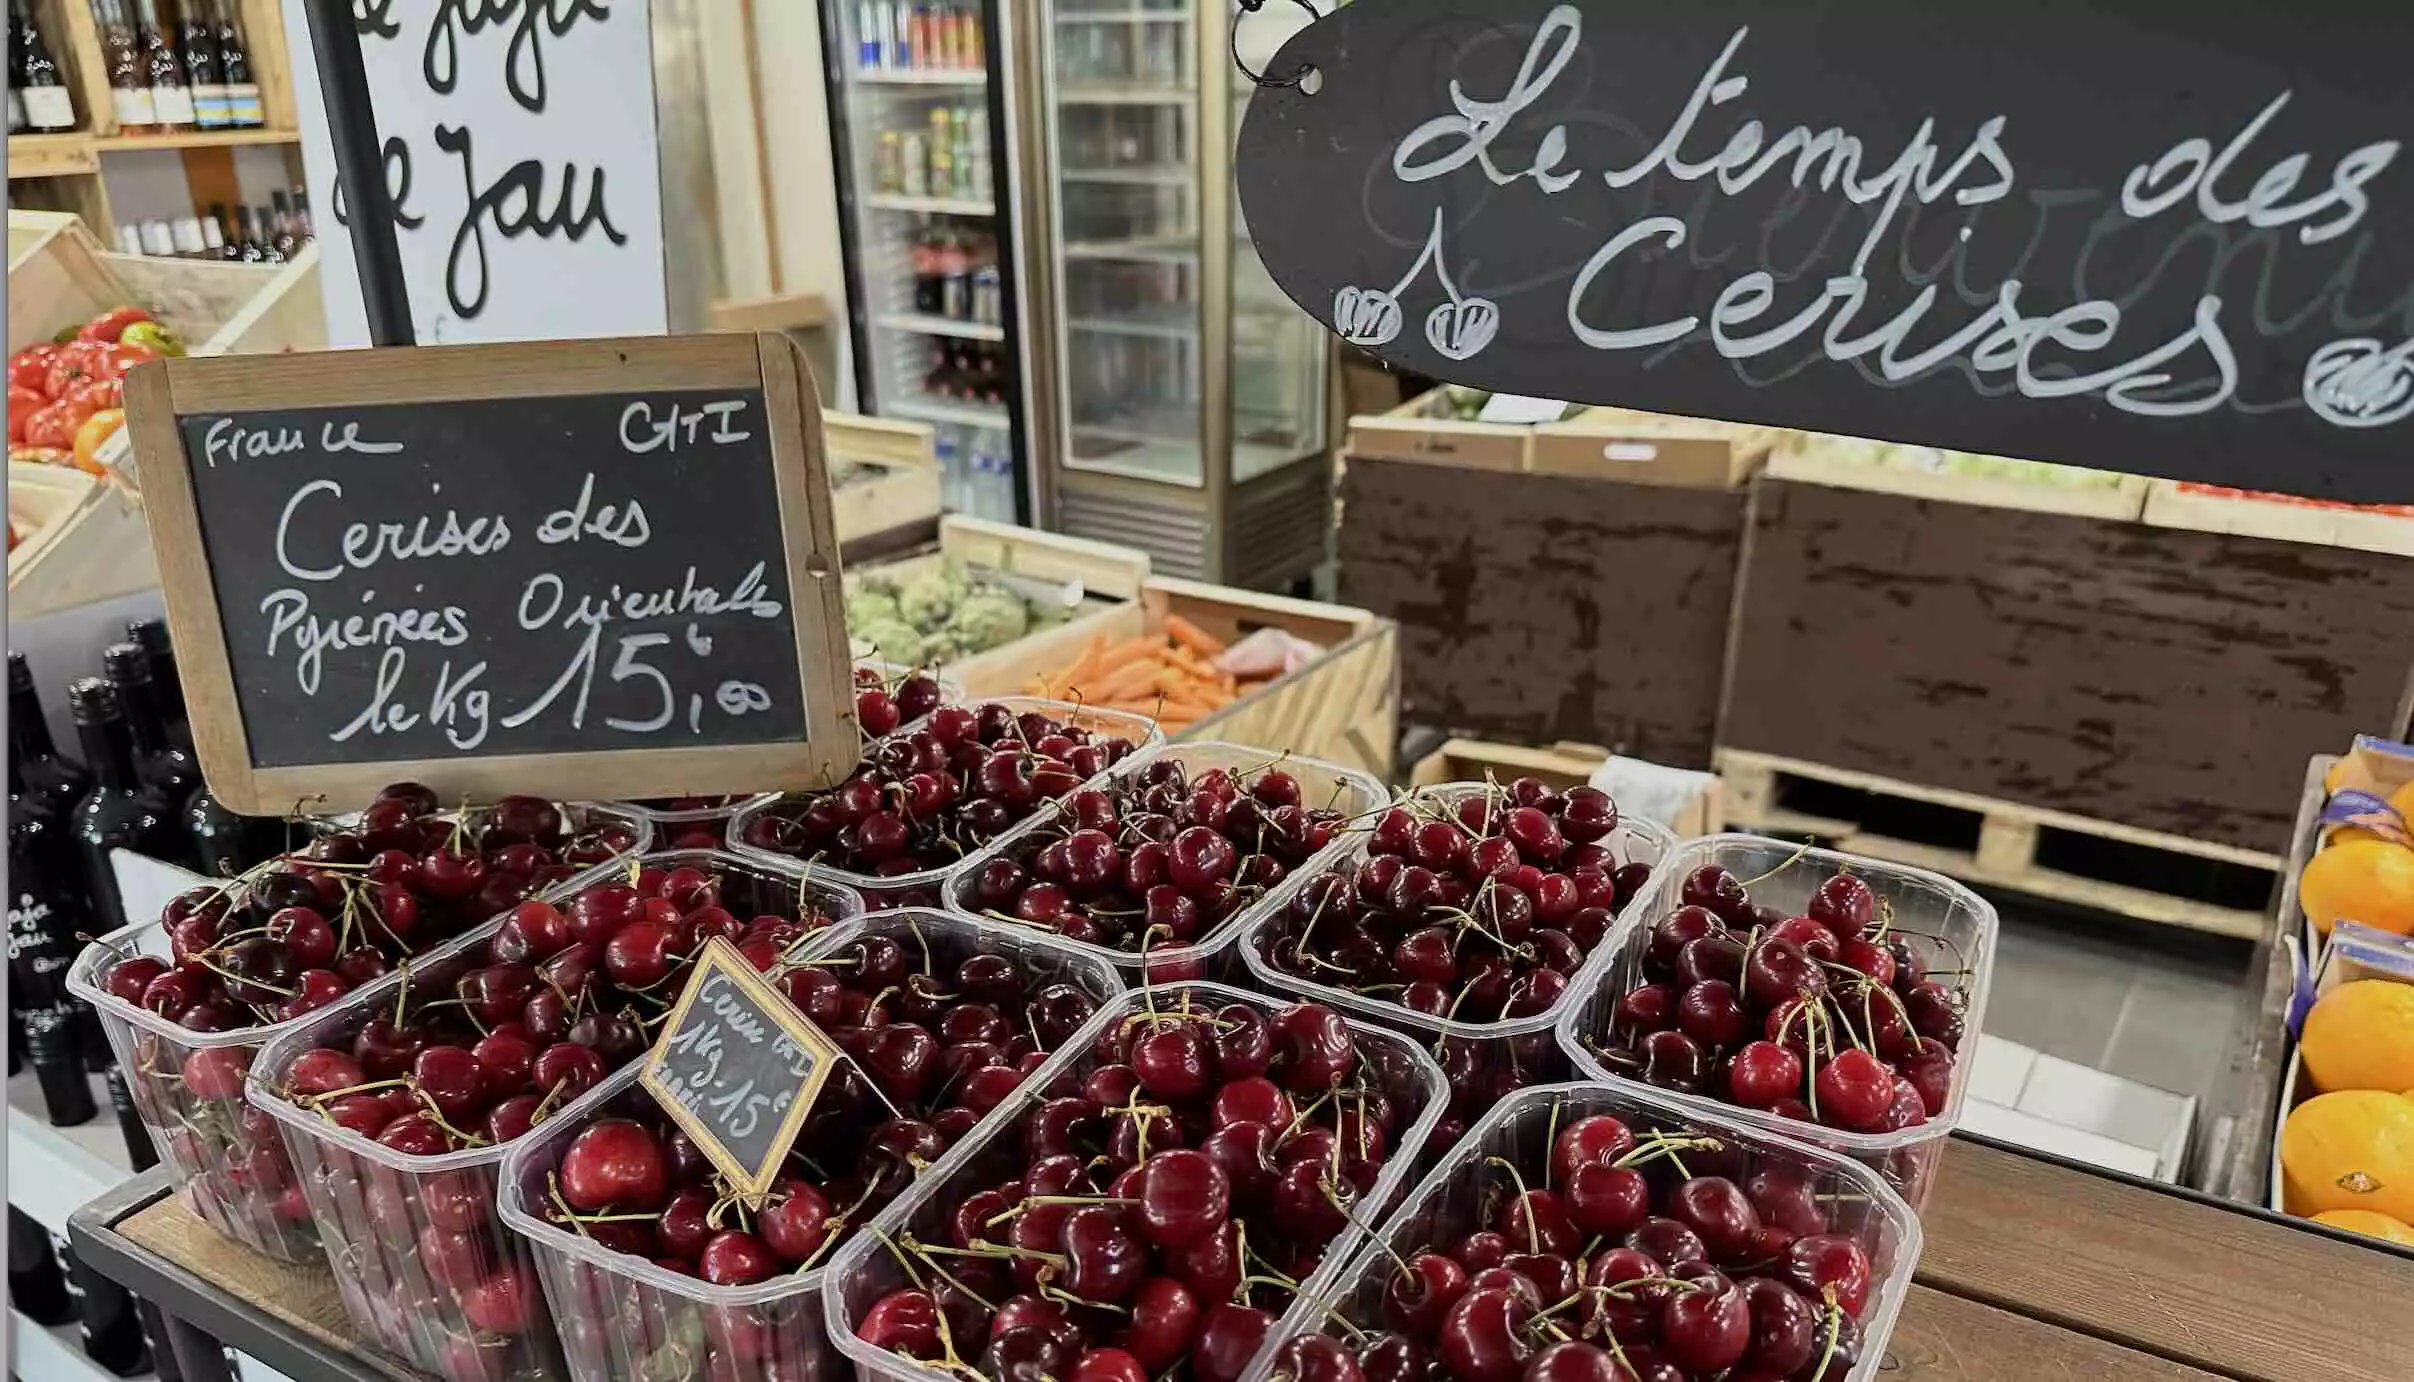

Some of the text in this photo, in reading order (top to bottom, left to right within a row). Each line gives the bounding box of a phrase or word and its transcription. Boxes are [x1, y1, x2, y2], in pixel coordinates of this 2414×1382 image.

[332, 136, 424, 228] e
[1394, 4, 2400, 277] Le temps des
[1568, 216, 2238, 416] Cerises
[276, 472, 651, 580] Cerises des
